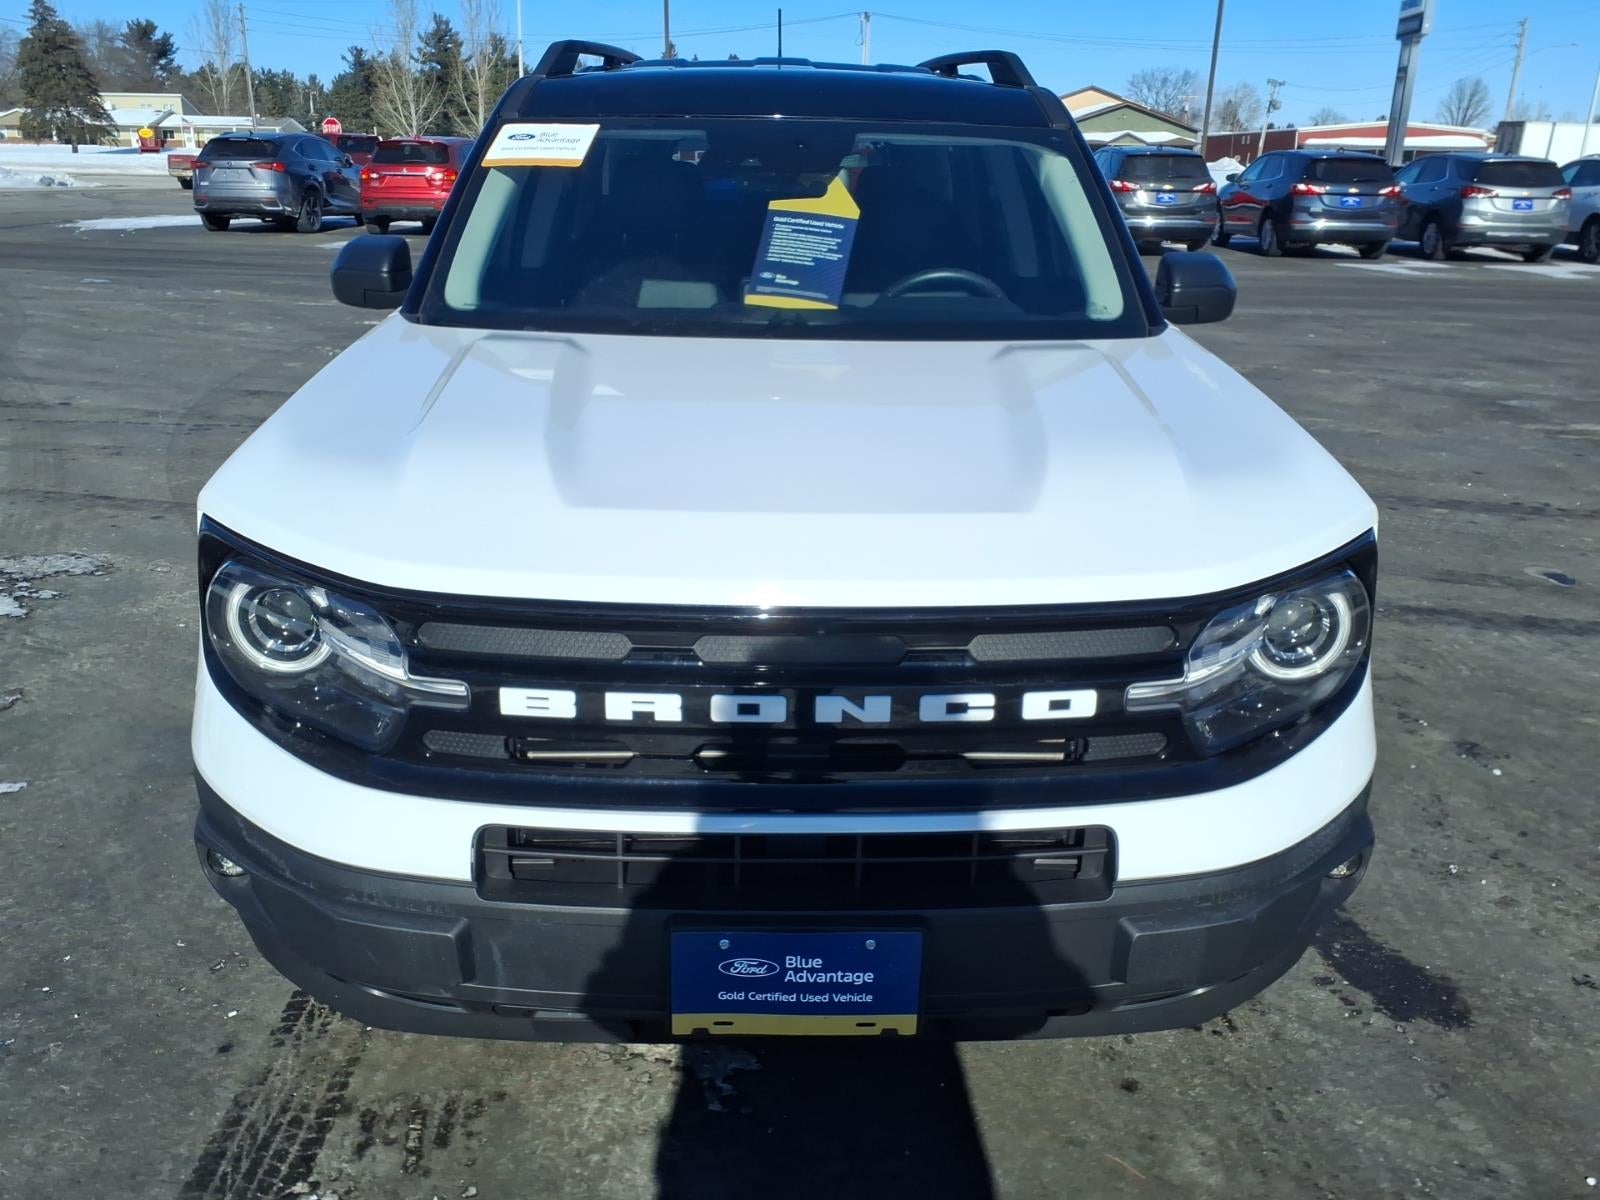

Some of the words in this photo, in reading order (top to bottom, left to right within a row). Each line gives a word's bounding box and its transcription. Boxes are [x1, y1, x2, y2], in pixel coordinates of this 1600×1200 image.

[323, 124, 340, 133] STOP
[499, 687, 1098, 723] BRONCO
[729, 959, 769, 976] Ford
[785, 955, 823, 969] Blue
[784, 970, 874, 985] Advantage
[718, 991, 745, 1001] Gold
[748, 991, 797, 1002] Certified
[800, 992, 829, 1003] Used
[832, 993, 873, 1003] Vehicle
